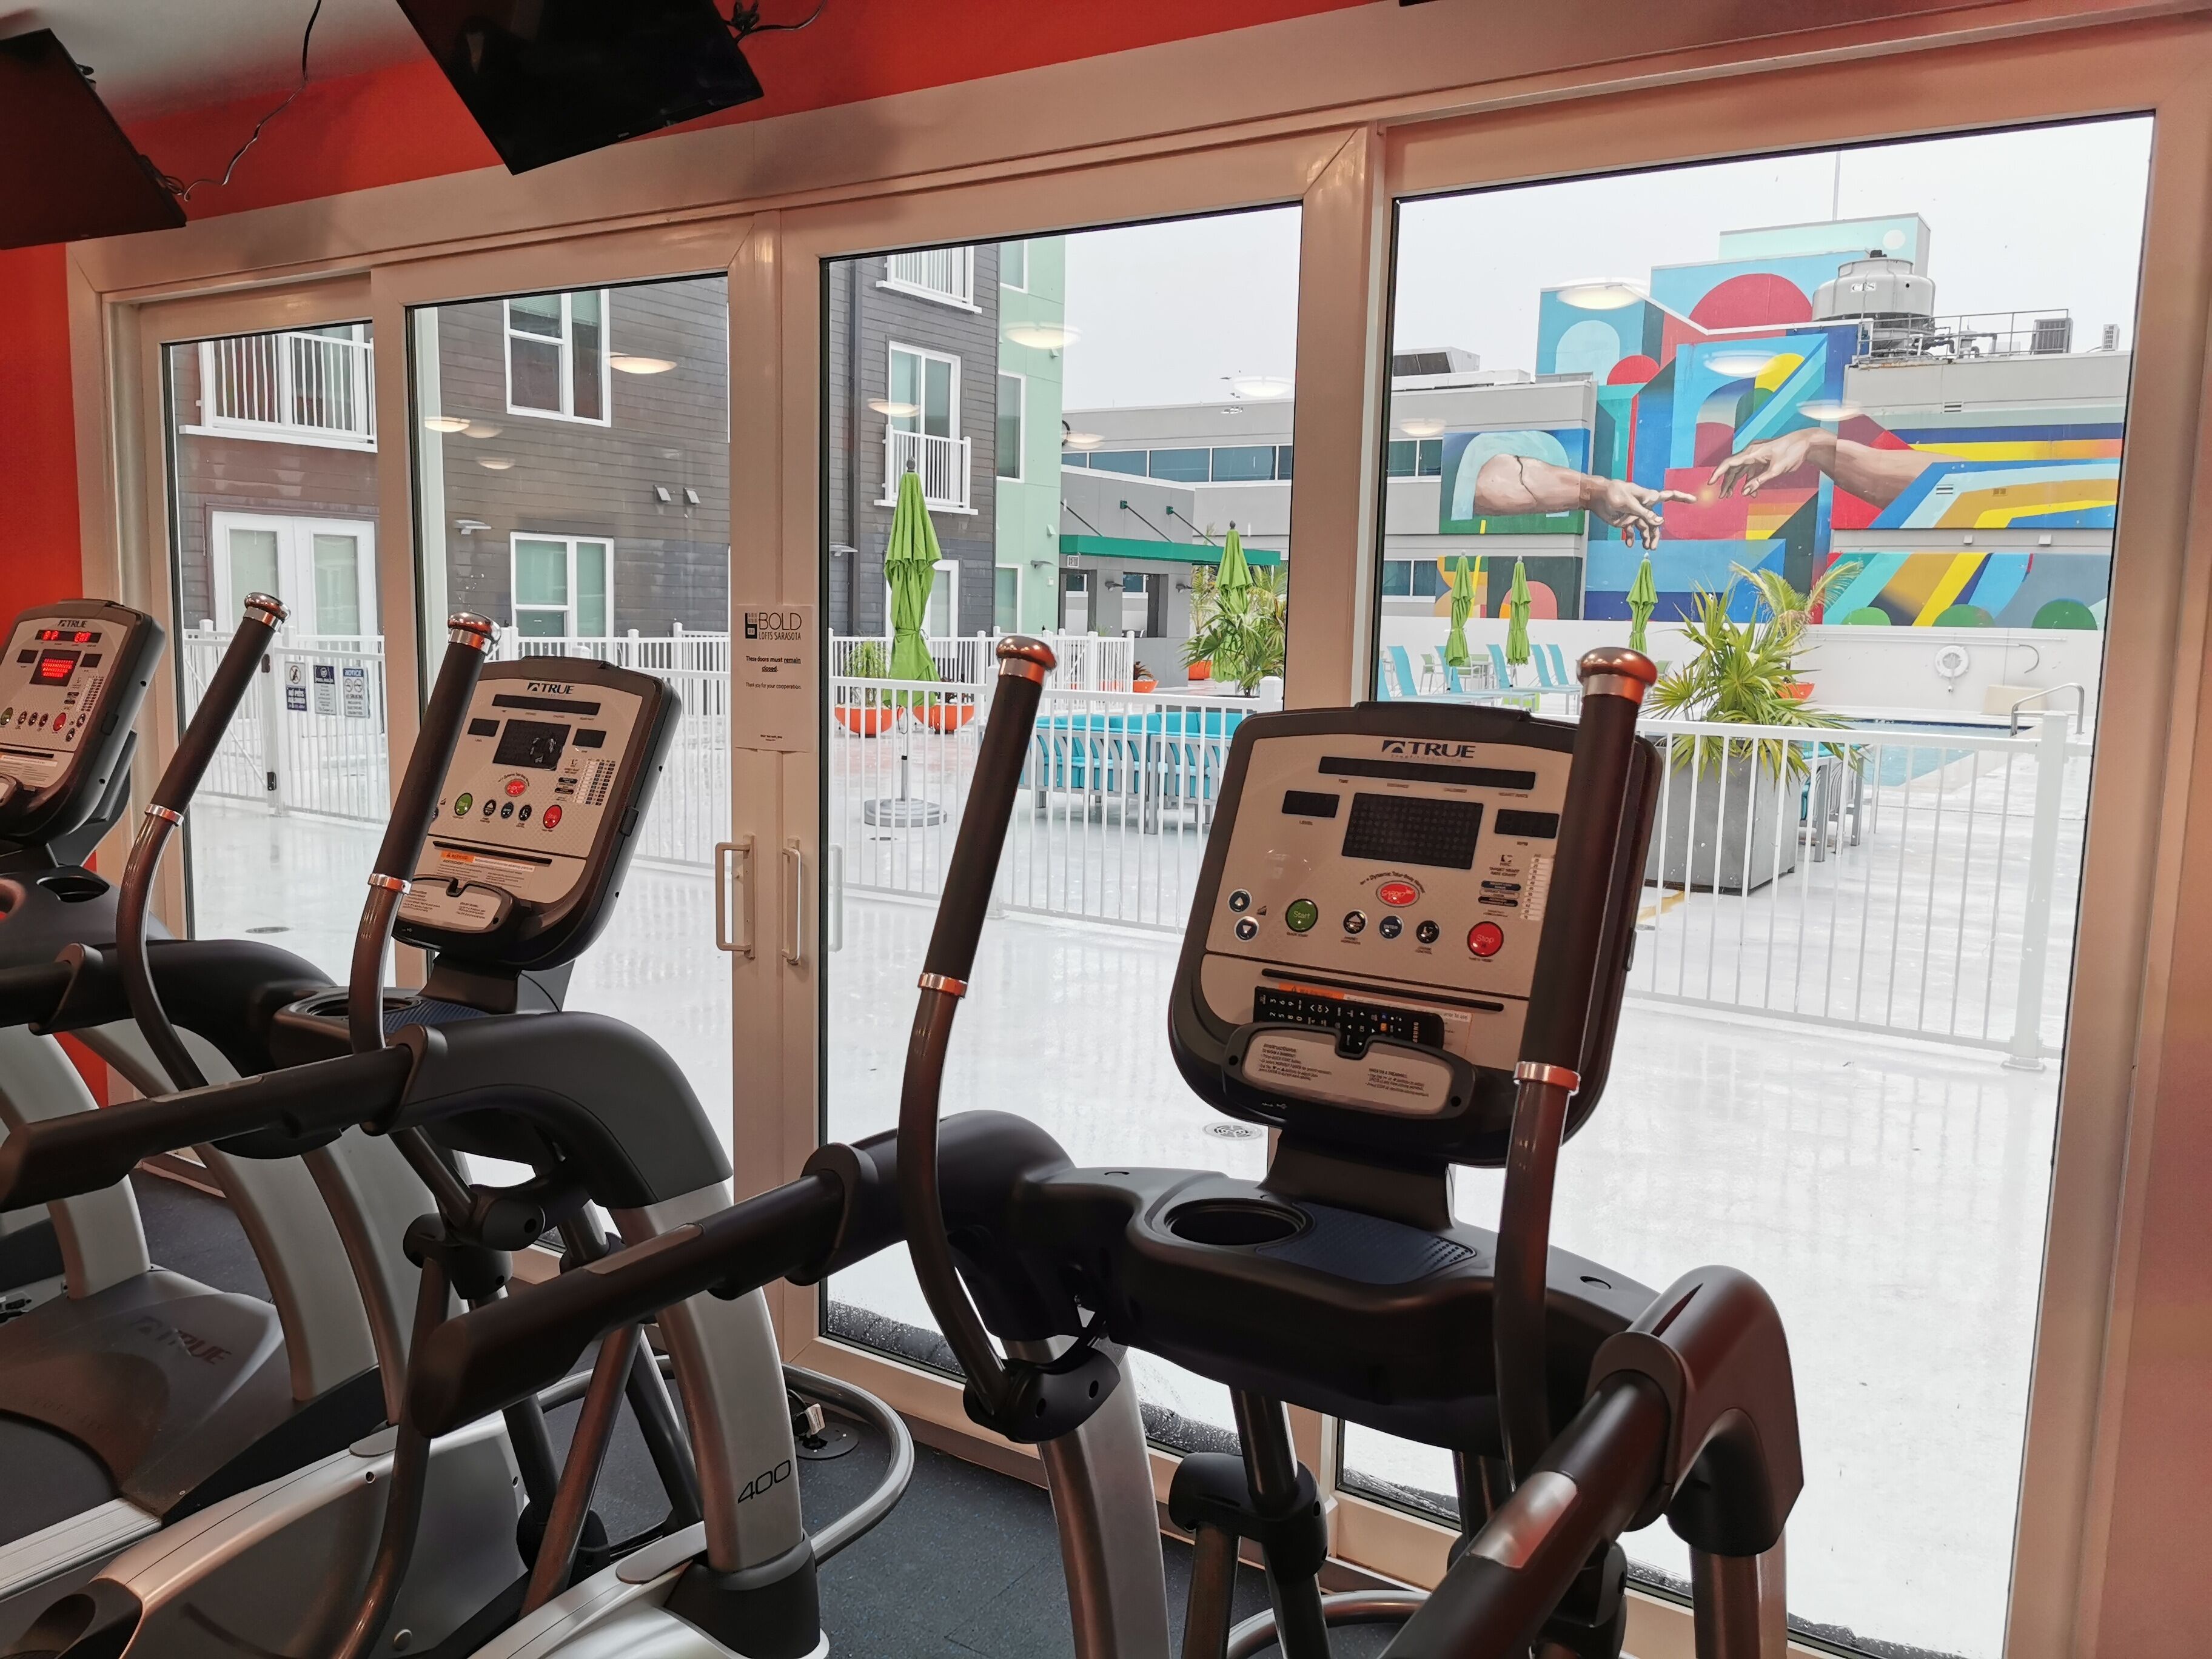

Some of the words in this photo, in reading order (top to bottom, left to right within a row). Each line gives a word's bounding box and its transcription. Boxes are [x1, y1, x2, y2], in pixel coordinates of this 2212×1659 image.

[67, 620, 88, 628] TRUE
[759, 612, 802, 630] BOLD
[774, 632, 802, 640] SARASOTA
[541, 683, 575, 694] TRUE
[1408, 741, 1476, 759] TRUE
[1293, 910, 1311, 919] Start
[1476, 934, 1495, 944] Stop
[737, 1460, 791, 1504] 400
